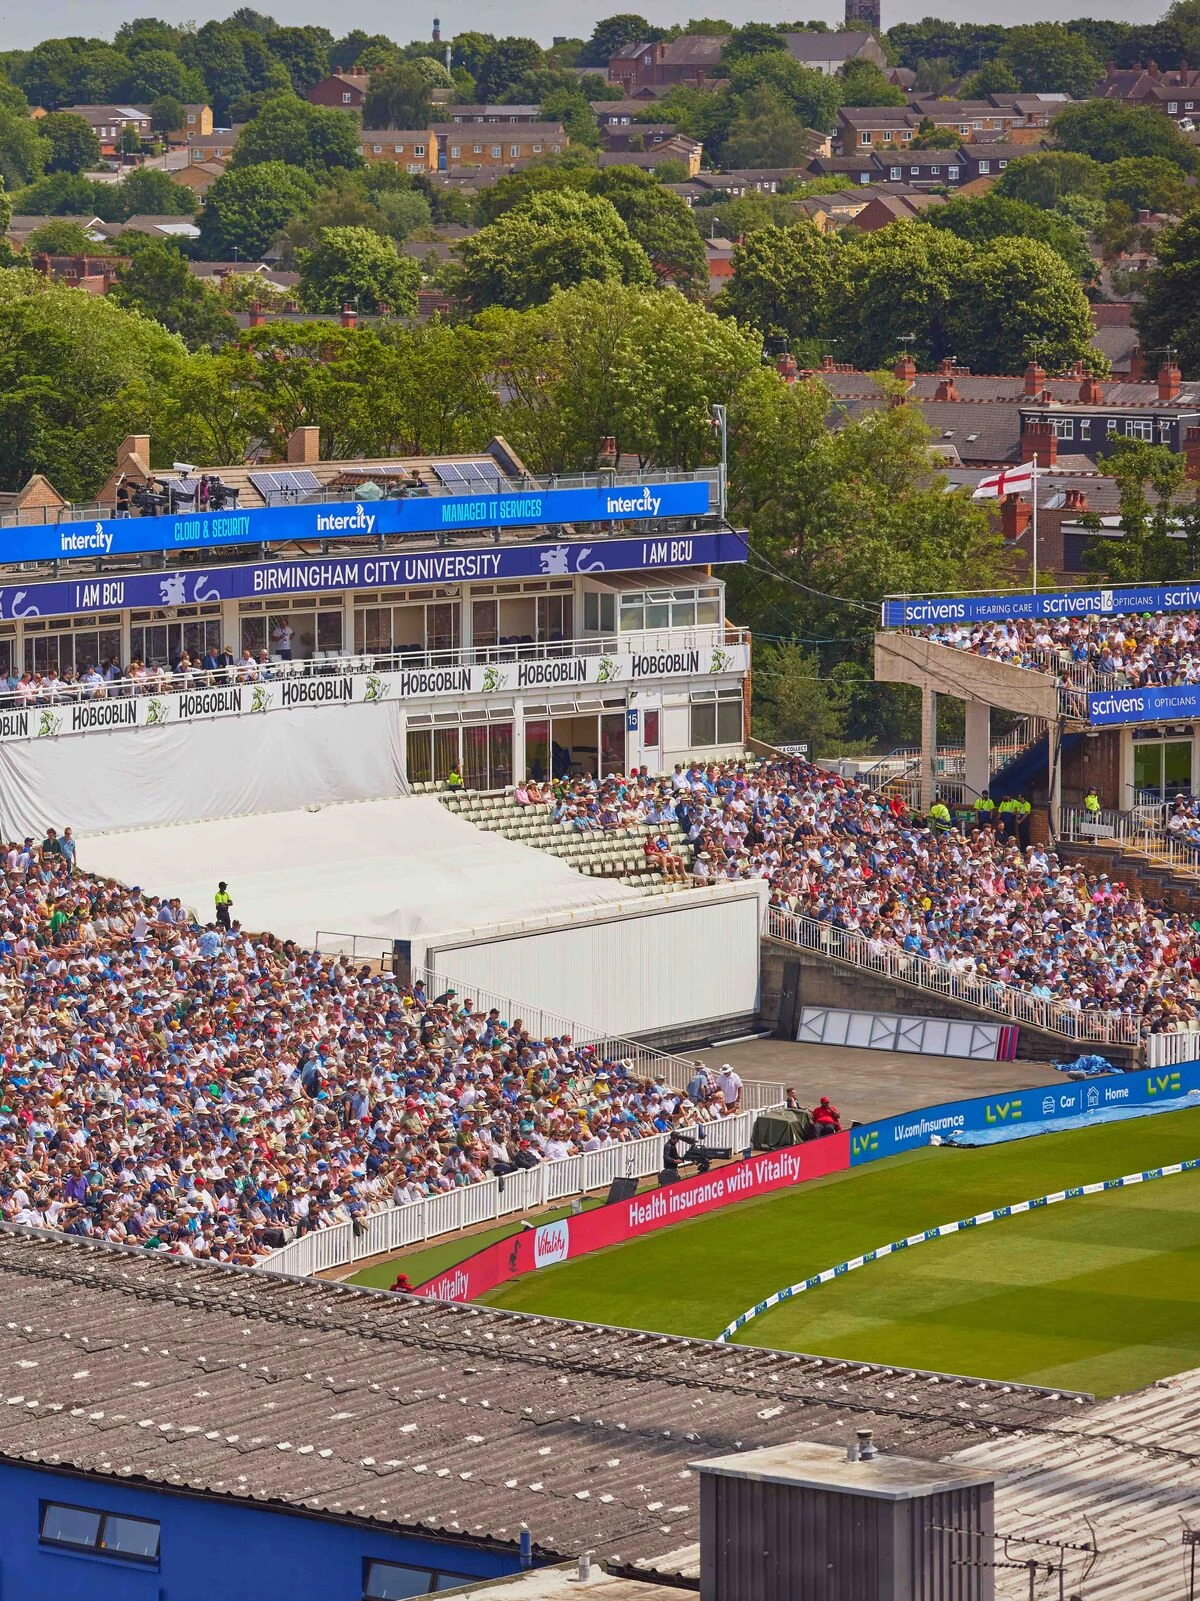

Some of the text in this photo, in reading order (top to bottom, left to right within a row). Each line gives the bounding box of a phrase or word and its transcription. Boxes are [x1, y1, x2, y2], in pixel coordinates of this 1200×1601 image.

[441, 499, 542, 523] MANAGED IT SERVICES
[607, 487, 661, 515] intercity
[174, 517, 250, 542] CLOUD & SECURITY
[317, 504, 375, 533] intercity
[61, 523, 113, 552] intercity
[650, 542, 668, 563] AM
[671, 540, 693, 562] BCU
[254, 554, 502, 591] BIRMINGHAM CITY UNIVERSITY
[76, 582, 125, 607] I AM BCU
[906, 594, 1153, 620] scrivens HEARING CARE scrivens OPTICIANS
[1102, 594, 1112, 608] 16
[1165, 587, 1200, 606] scriv
[518, 660, 587, 686] HOBGOBLIN
[631, 651, 699, 677] HOBGOBLIN
[282, 678, 353, 705] HOBGOBLIN
[400, 669, 471, 696] HOBGOBLIN
[72, 701, 137, 730] HOBGOBLIN
[179, 689, 242, 718] HOBGOBLIN
[1092, 695, 1196, 715] scrivens OPTICIANS
[628, 714, 637, 725] 15
[1060, 1087, 1129, 1108] Car Home
[894, 1114, 965, 1141] LV.com/insurance
[629, 1153, 801, 1227] Health insurance with Vitality
[537, 1228, 566, 1258] Vitality
[438, 1270, 469, 1300] Vitality
